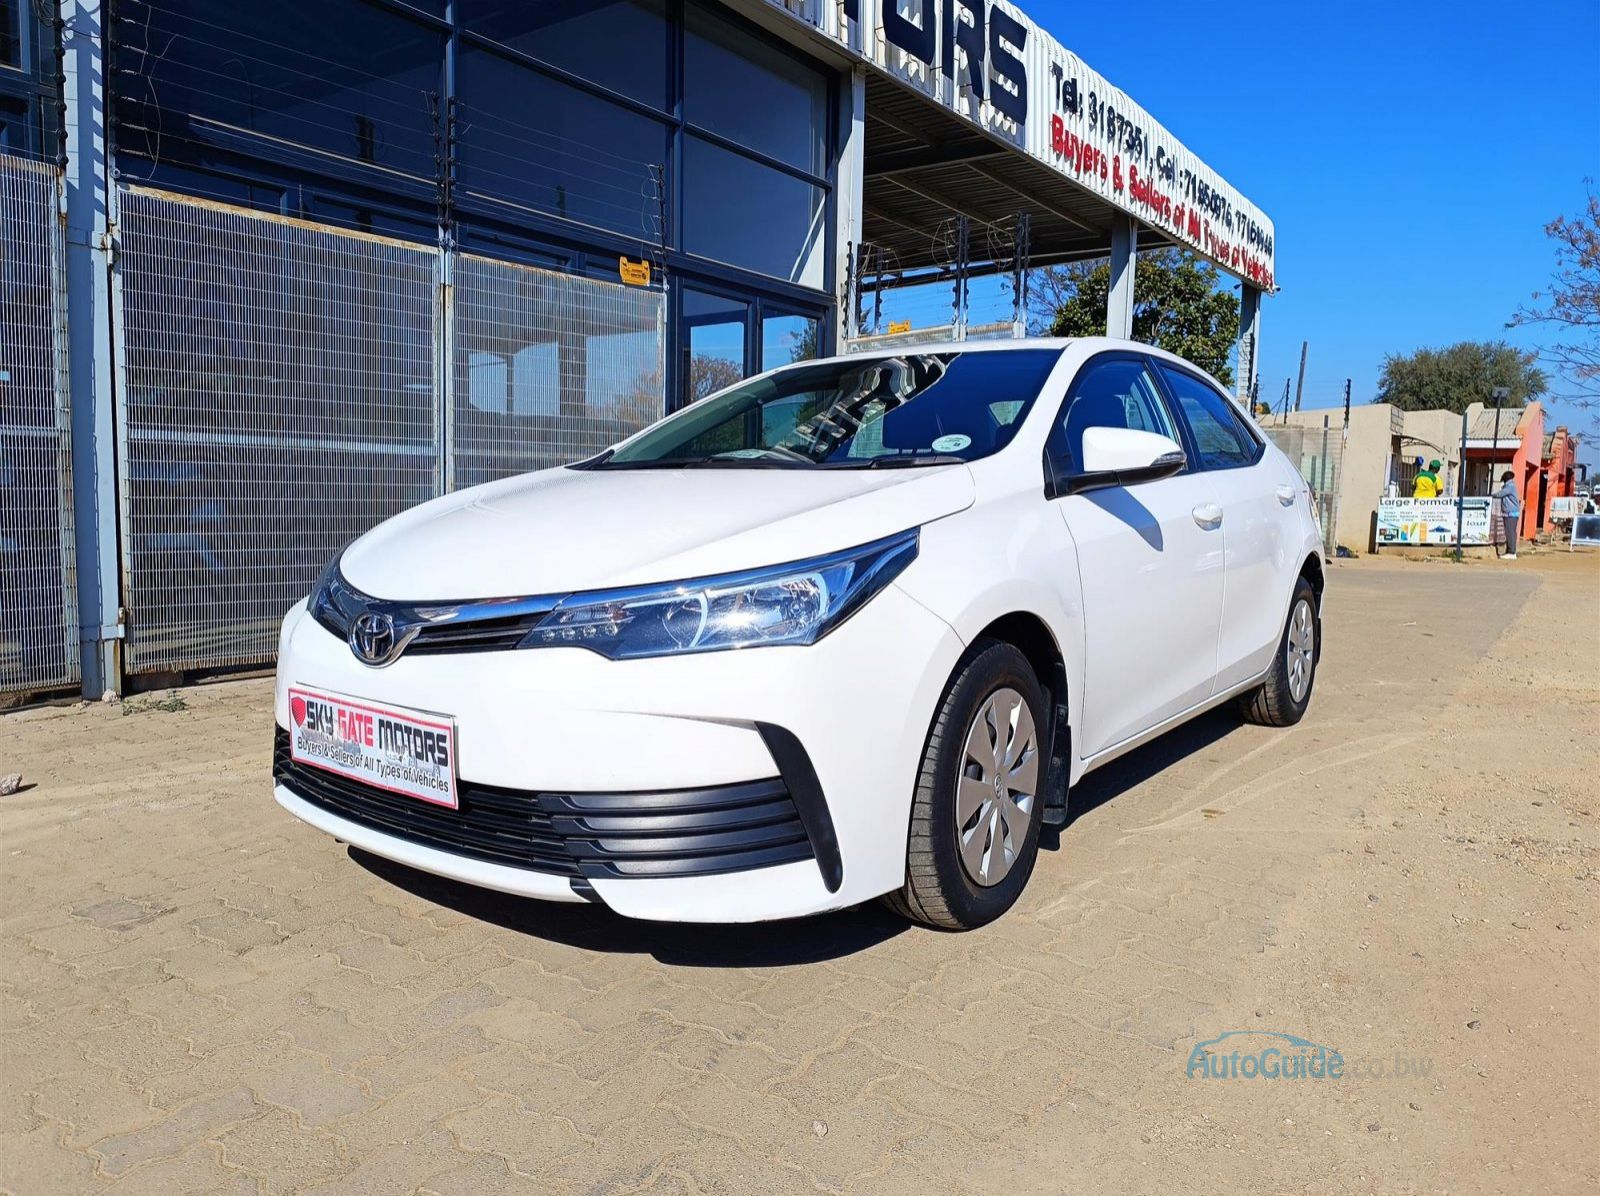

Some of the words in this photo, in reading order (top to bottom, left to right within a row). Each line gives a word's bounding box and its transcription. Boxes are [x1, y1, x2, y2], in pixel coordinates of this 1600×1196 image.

[1052, 113, 1107, 179] Buyers
[1113, 155, 1124, 191] &
[1129, 165, 1171, 219] Sellers
[1173, 202, 1185, 229] of
[1188, 208, 1201, 242] All
[1202, 217, 1230, 263] Types
[1231, 244, 1241, 268] of
[1241, 246, 1273, 290] Vehicles
[1379, 496, 1410, 507] Large
[1413, 498, 1452, 506] Format
[297, 736, 322, 755] Buyers
[323, 743, 329, 757] &
[330, 745, 354, 766] Sellers
[355, 754, 363, 768] of
[364, 756, 374, 772] All
[376, 759, 401, 779] Types
[403, 766, 411, 781] of
[412, 767, 449, 793] Vehicles
[306, 700, 334, 736] SKY
[337, 708, 374, 747] GATE
[378, 718, 449, 767] MOTORS
